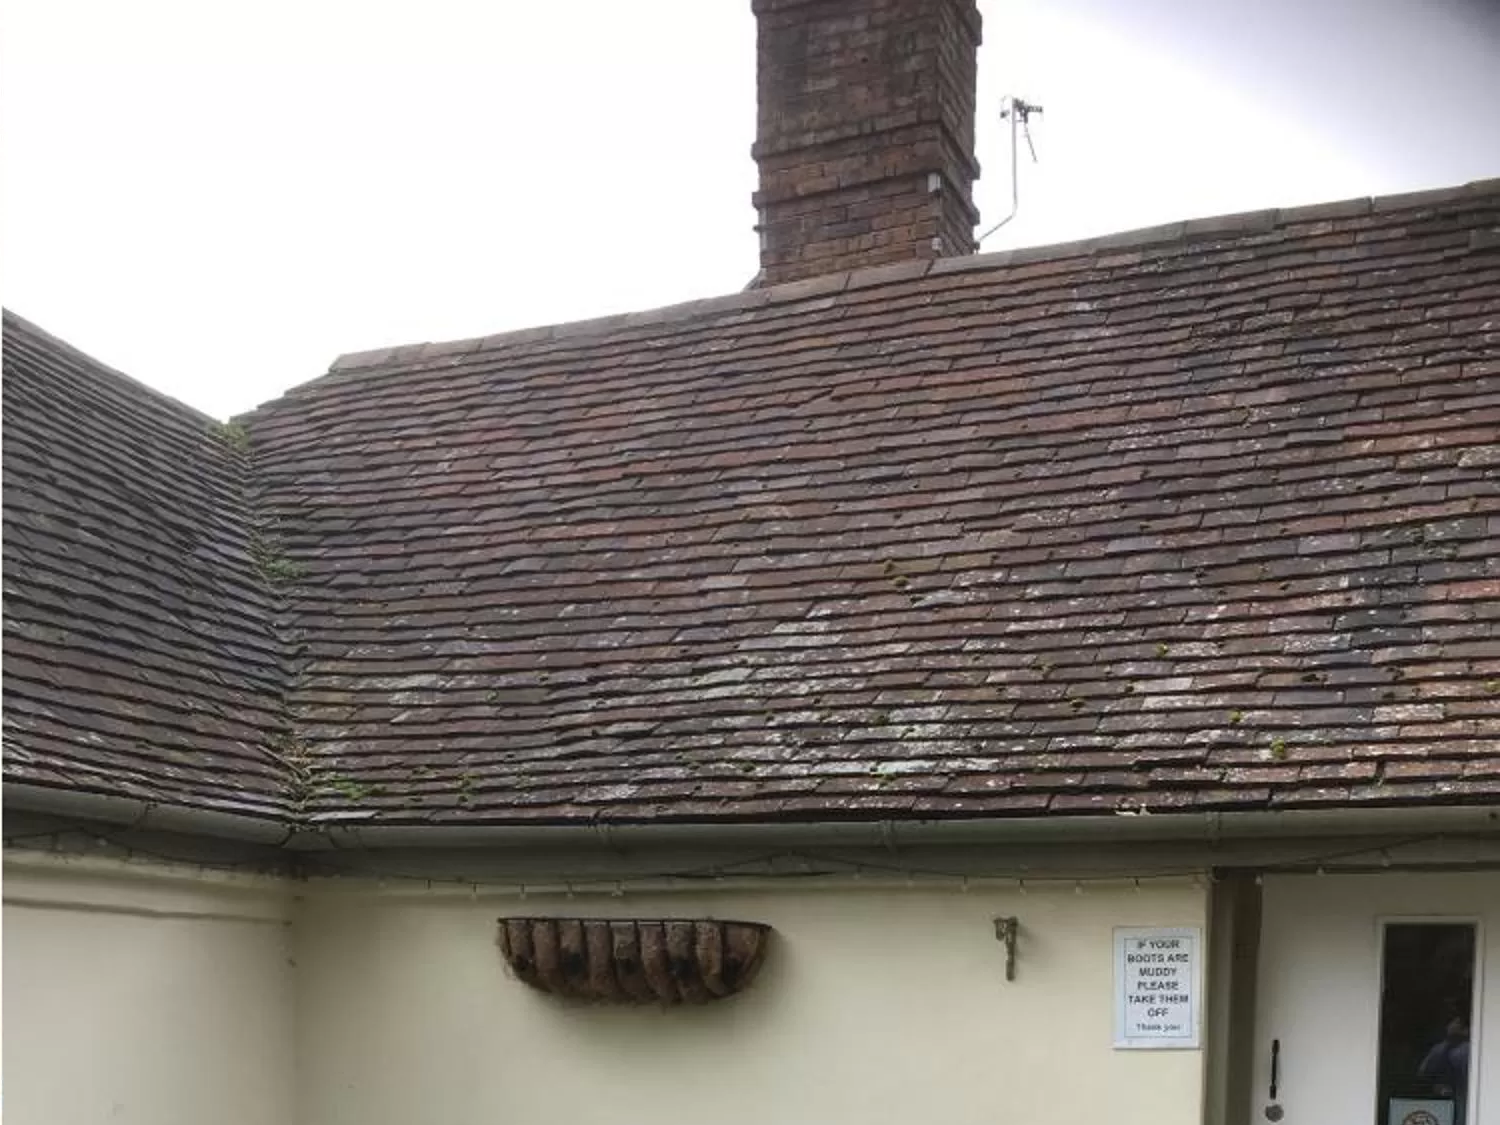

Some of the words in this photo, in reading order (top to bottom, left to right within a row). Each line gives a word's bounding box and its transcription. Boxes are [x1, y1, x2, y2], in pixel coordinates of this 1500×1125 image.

[1127, 953, 1164, 963] BOOTS
[1167, 953, 1189, 963] ARE
[1138, 967, 1177, 977] MUDDY
[1137, 980, 1179, 991] PLEASE
[1128, 994, 1157, 1004] TAKE
[1159, 994, 1189, 1004] THEM
[1147, 1007, 1169, 1017] OFF
